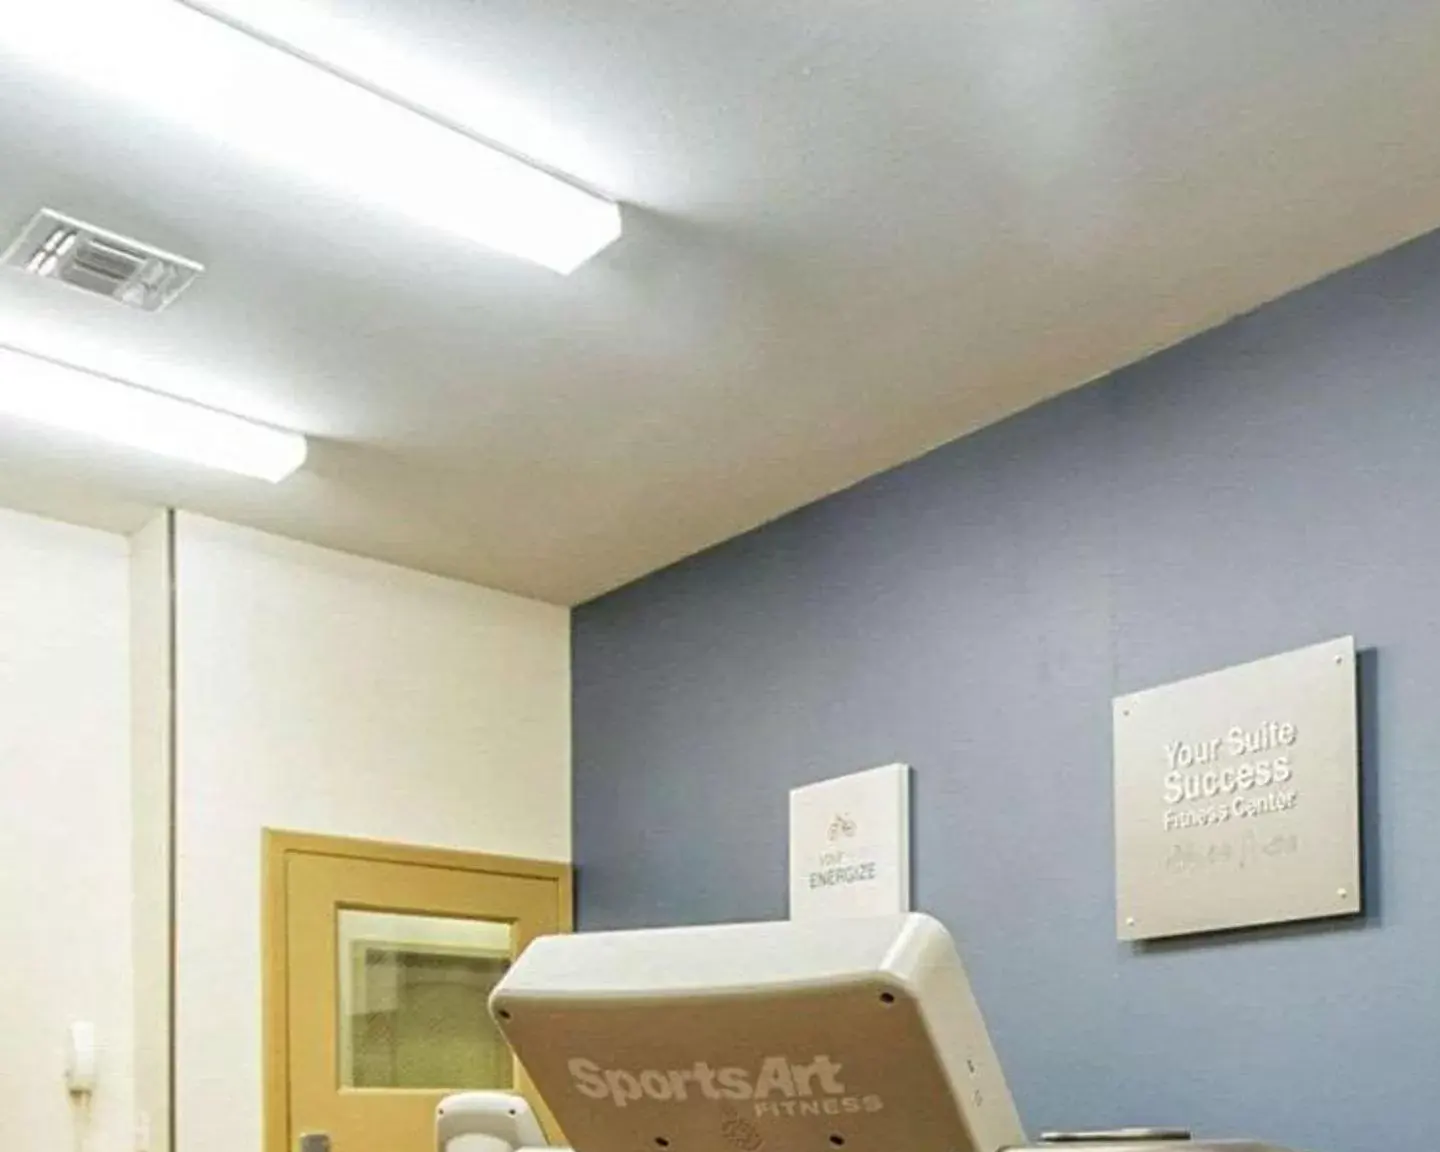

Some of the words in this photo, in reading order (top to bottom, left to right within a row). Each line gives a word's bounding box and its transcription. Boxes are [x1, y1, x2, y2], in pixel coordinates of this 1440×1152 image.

[1164, 738, 1222, 769] Your
[1228, 721, 1298, 756] Suite
[1163, 757, 1293, 804] Success
[1232, 789, 1299, 817] Center
[809, 862, 877, 890] ENERGIZE
[567, 1055, 846, 1108] SportsArt
[753, 1094, 884, 1118] FITNESS
